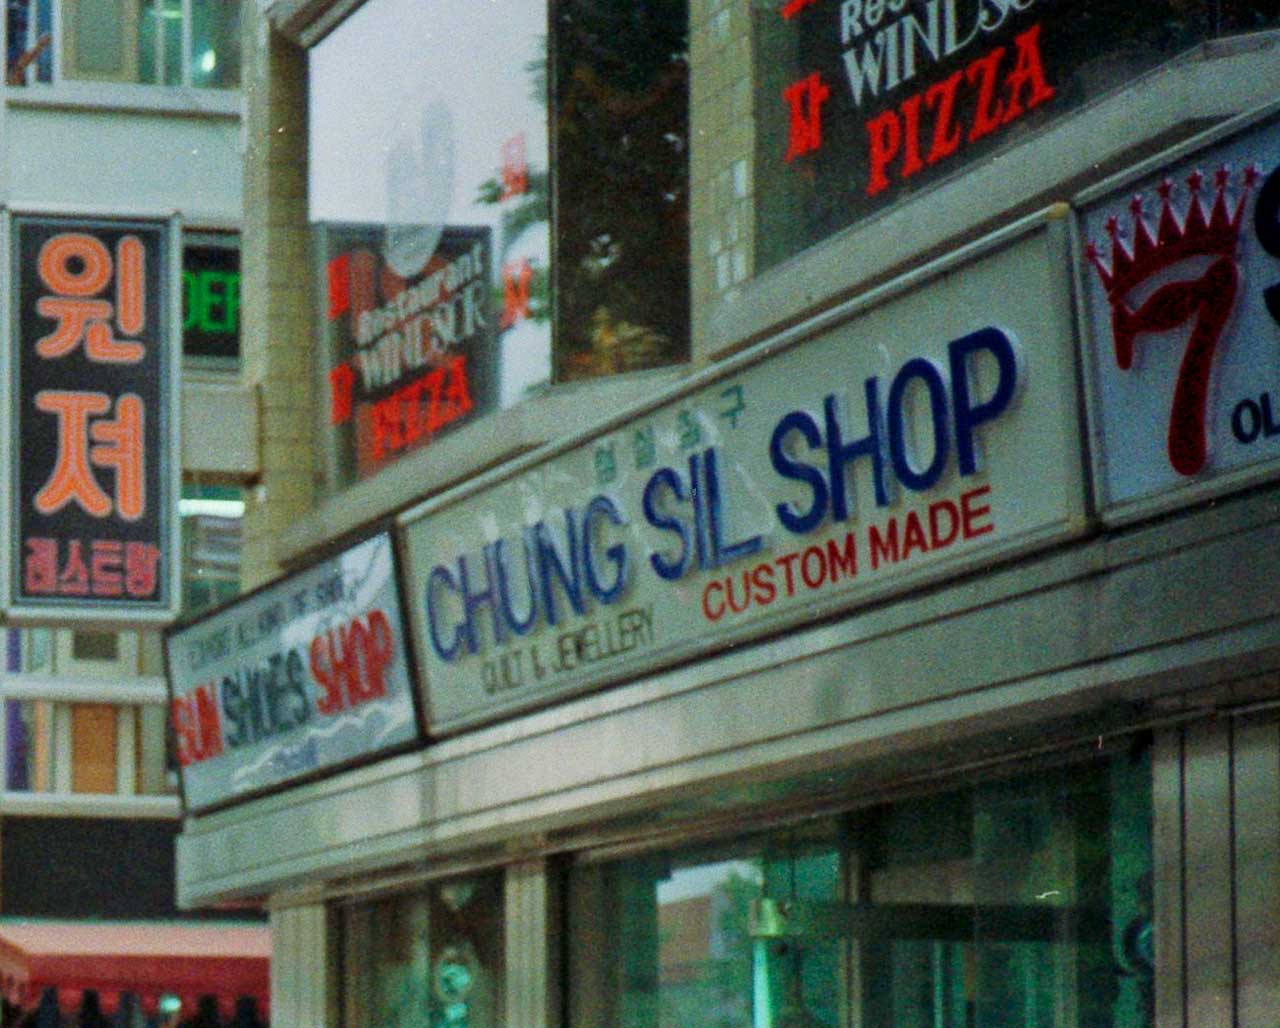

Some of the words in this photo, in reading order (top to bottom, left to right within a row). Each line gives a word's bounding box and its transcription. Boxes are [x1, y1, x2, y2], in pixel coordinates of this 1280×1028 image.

[864, 24, 1057, 197] PIZZA
[426, 494, 628, 665] CHUNG
[642, 446, 764, 582] SIL
[768, 326, 1020, 537] SHOP
[701, 532, 858, 622] CUSTOM
[869, 485, 995, 570] MADE
[309, 609, 393, 716] SHOP
